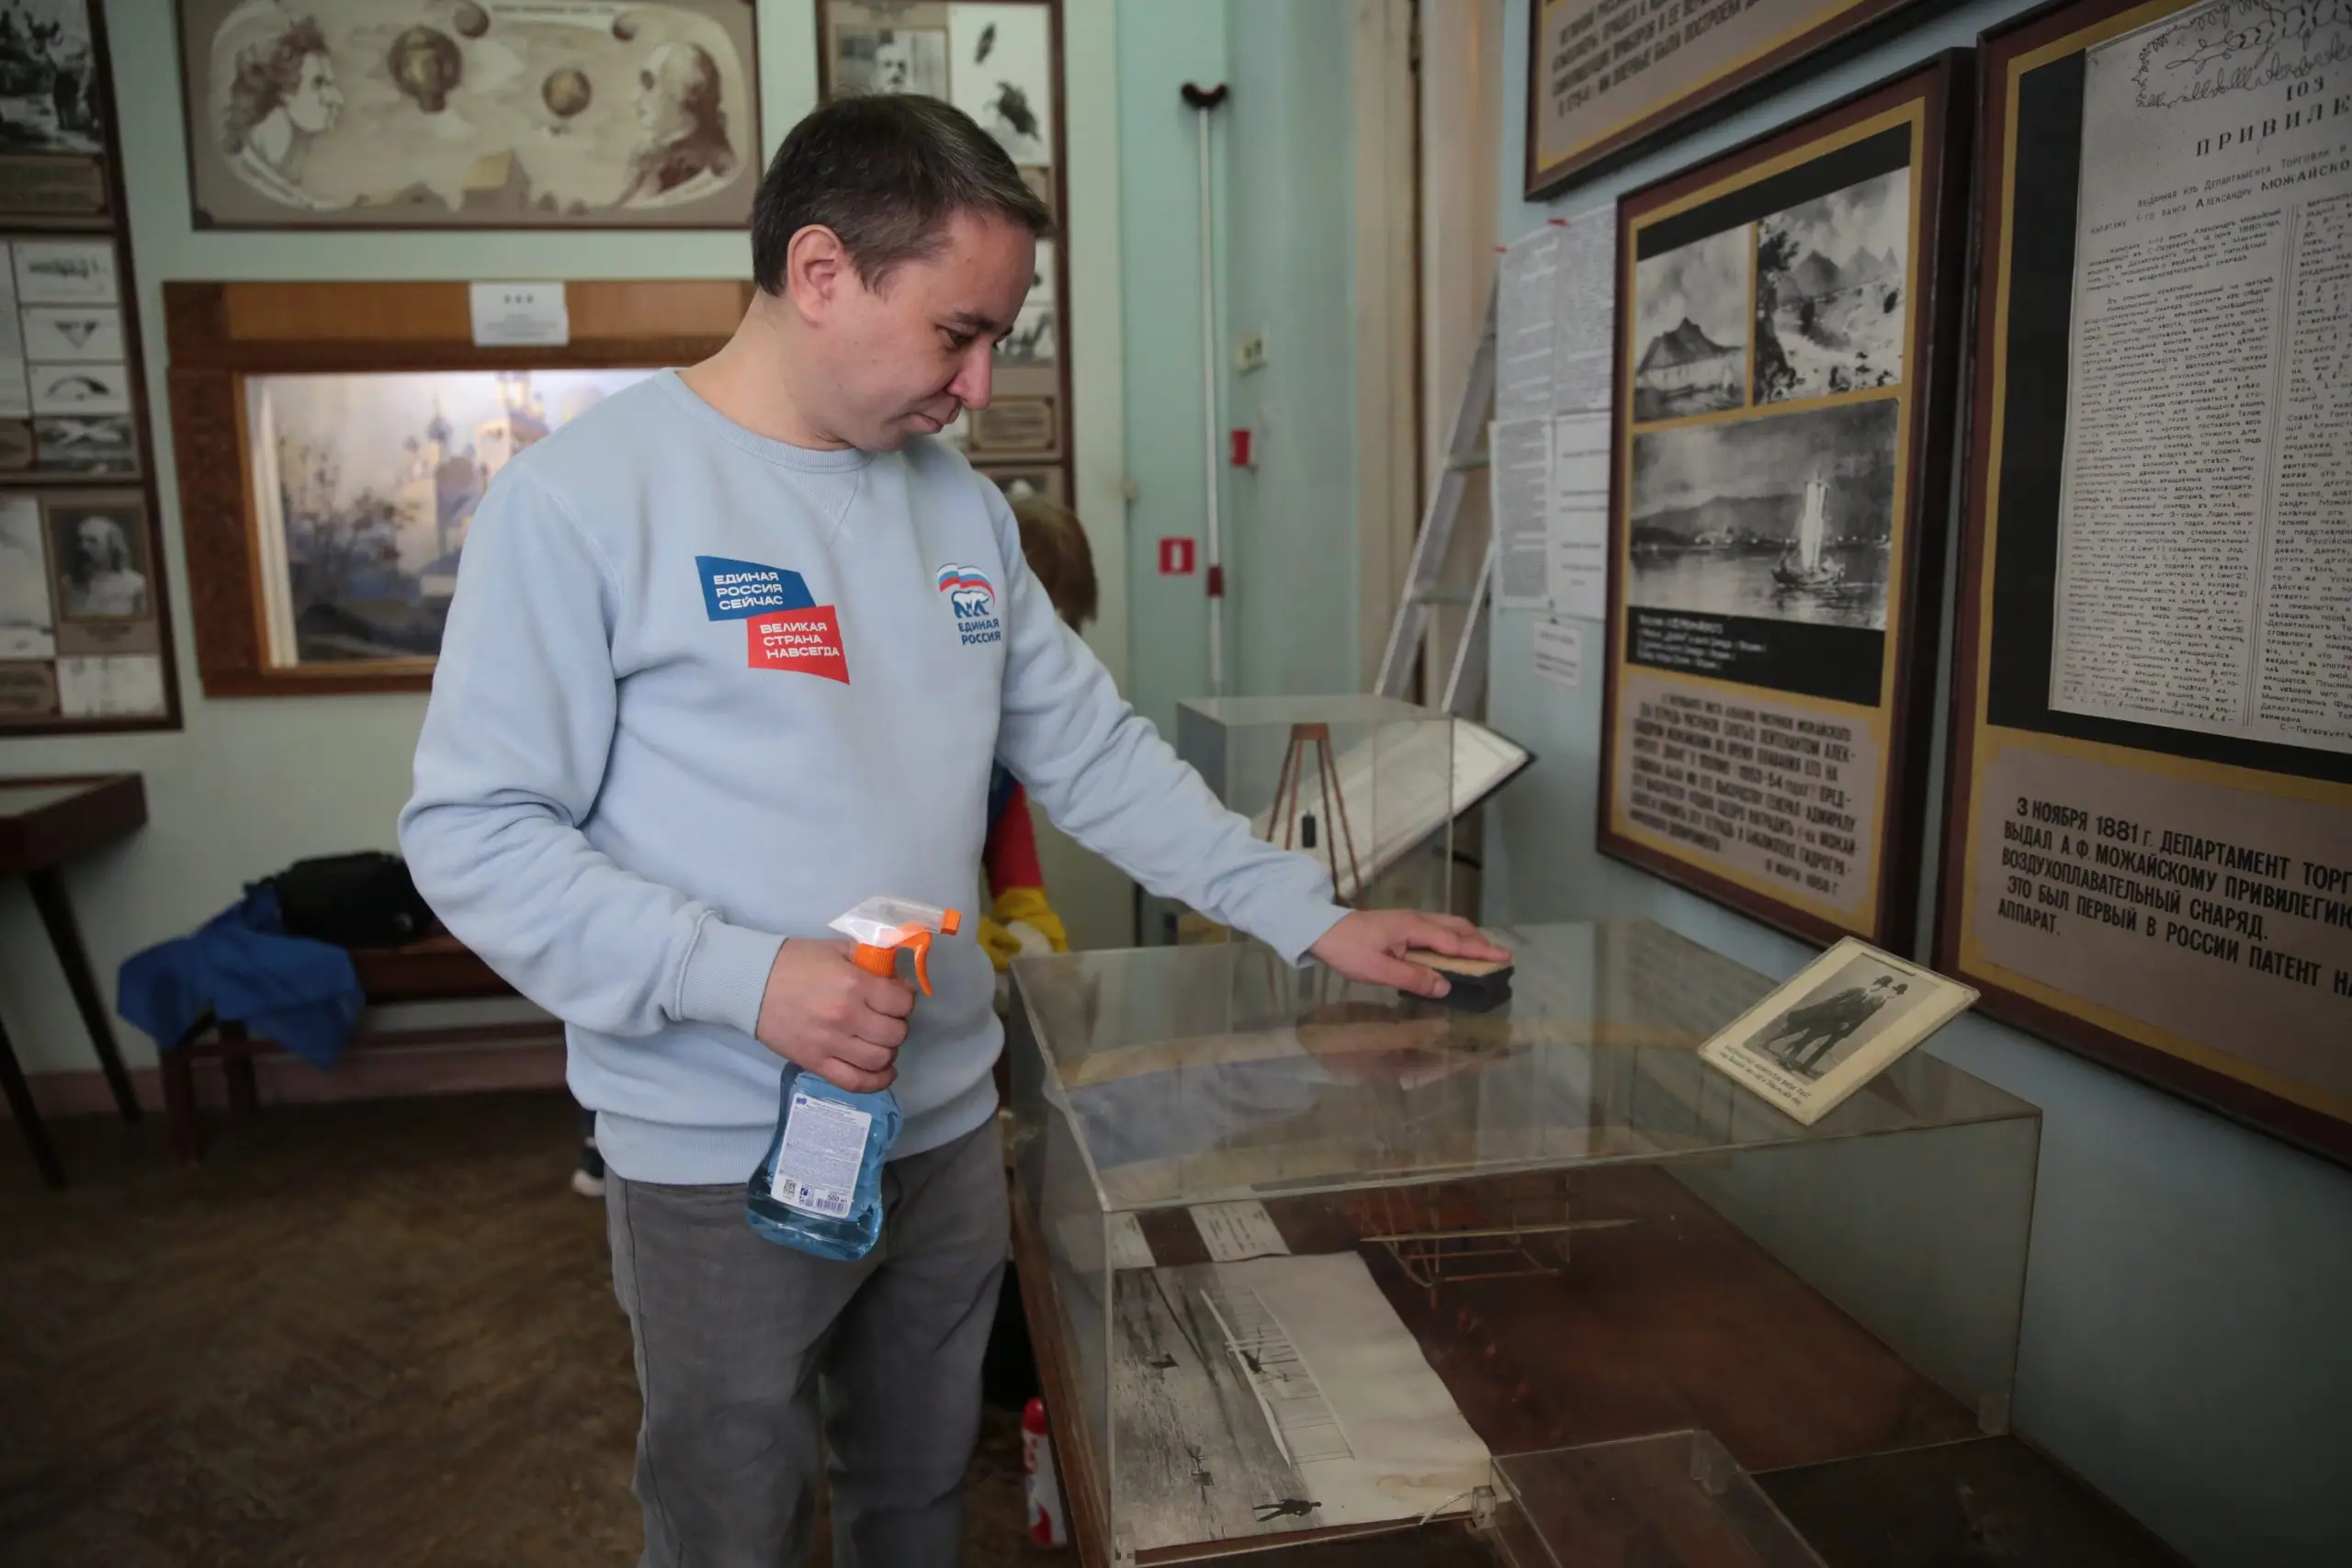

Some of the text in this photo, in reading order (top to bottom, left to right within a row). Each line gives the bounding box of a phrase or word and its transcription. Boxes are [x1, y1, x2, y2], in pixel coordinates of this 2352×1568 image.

[713, 571, 779, 585] ЕДИНАЯ
[716, 583, 783, 598] РОССИЯ
[718, 595, 784, 611] СЕЙЧАС
[760, 622, 828, 635] ВЕЛИКАЯ
[957, 618, 1000, 632] ЕДИНАЯ
[763, 634, 822, 646] СТРАНА
[961, 631, 1001, 646] РОССИЯ
[766, 646, 840, 660] НАВСЕГДА
[2017, 797, 2028, 817] 3
[2032, 800, 2087, 831] НОЯБРЯ
[2096, 816, 2138, 843] 1881
[2160, 829, 2290, 880] ДЕПАРТАМЕНТ
[2005, 820, 2052, 851] ВЫДАЛ
[2096, 843, 2218, 893] МОЖАЙСКОМУ
[2002, 846, 2268, 942] ВОЗДУХОПЛАВАТЕЛЬНЫЙ СНАРЯД.
[1998, 898, 2061, 936] АППАРАТ.
[2007, 875, 2032, 899] ЭТО
[2038, 884, 2070, 911] БЫЛ
[2076, 895, 2137, 931] ПЕРВЫЙ
[2146, 915, 2157, 937] В
[2166, 921, 2239, 964] РОССИИ
[2248, 945, 2322, 987] ПАТЕНТ
